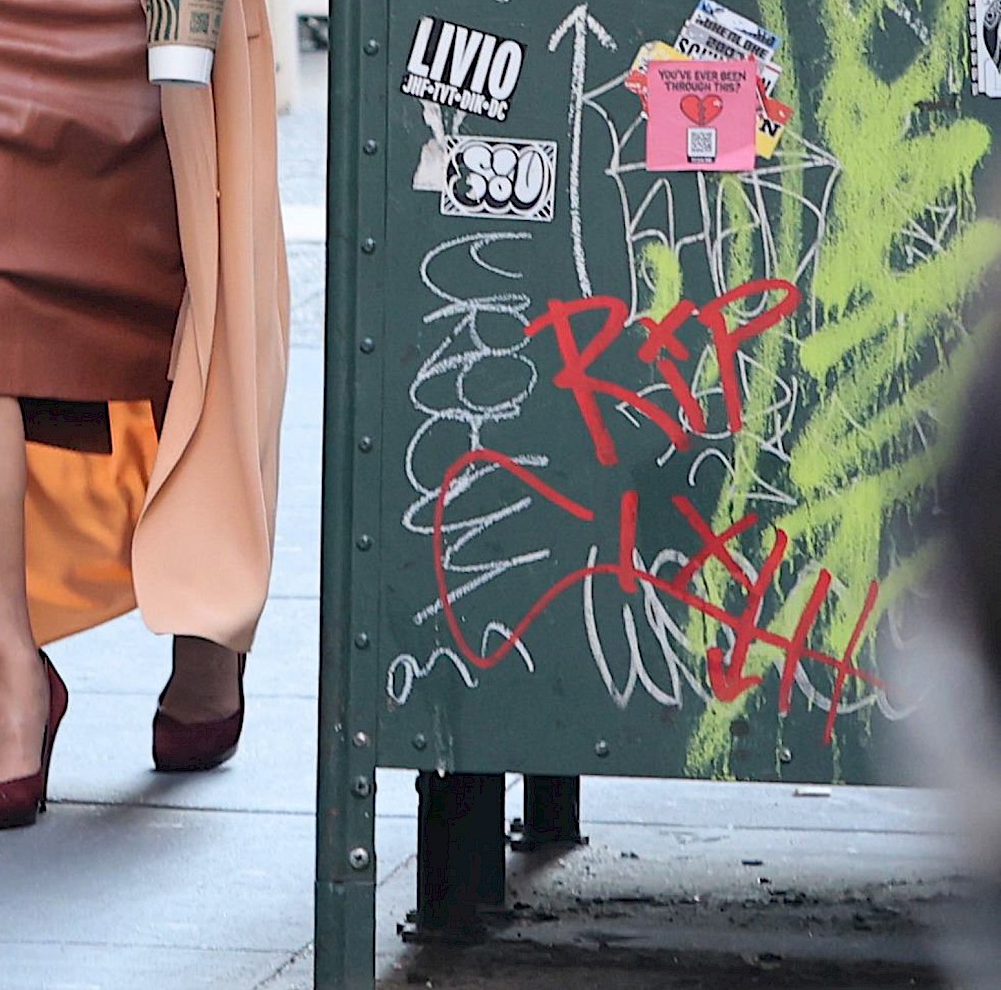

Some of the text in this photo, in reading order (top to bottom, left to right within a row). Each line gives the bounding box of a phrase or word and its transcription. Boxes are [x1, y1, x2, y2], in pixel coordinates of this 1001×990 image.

[407, 15, 524, 100] LIVIO
[694, 70, 718, 80] EVER
[719, 70, 747, 81] BEEN
[664, 81, 741, 93] THROUGH THIS?
